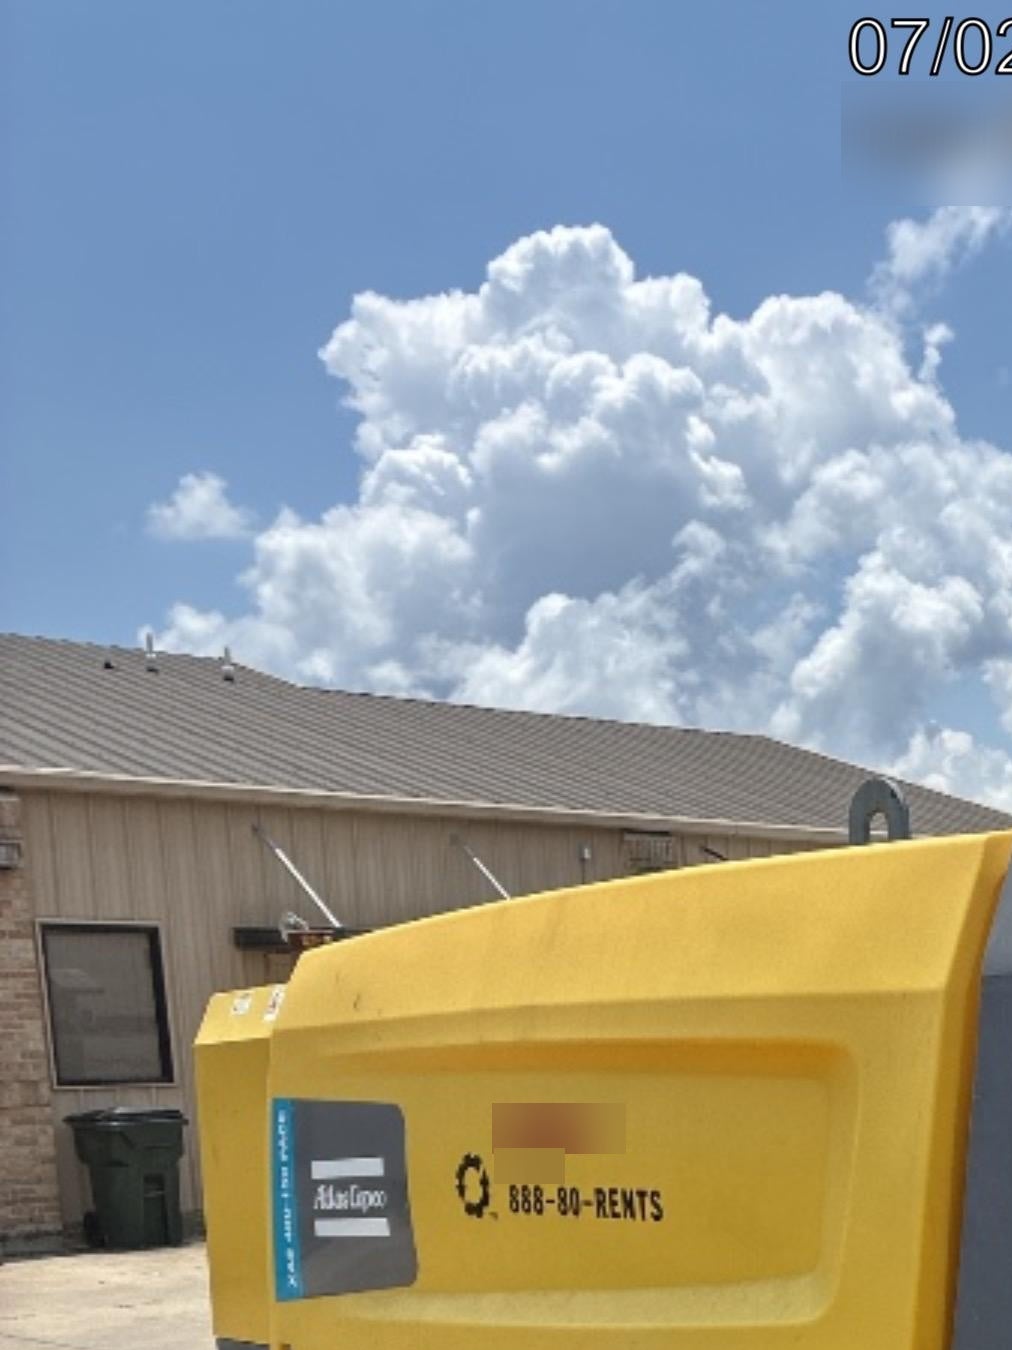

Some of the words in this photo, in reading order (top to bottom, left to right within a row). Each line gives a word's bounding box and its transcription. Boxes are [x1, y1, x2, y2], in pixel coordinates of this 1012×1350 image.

[313, 1184, 349, 1210] Atlas
[350, 1184, 388, 1214] Copco
[509, 1184, 664, 1222] 888-80-RENTS
